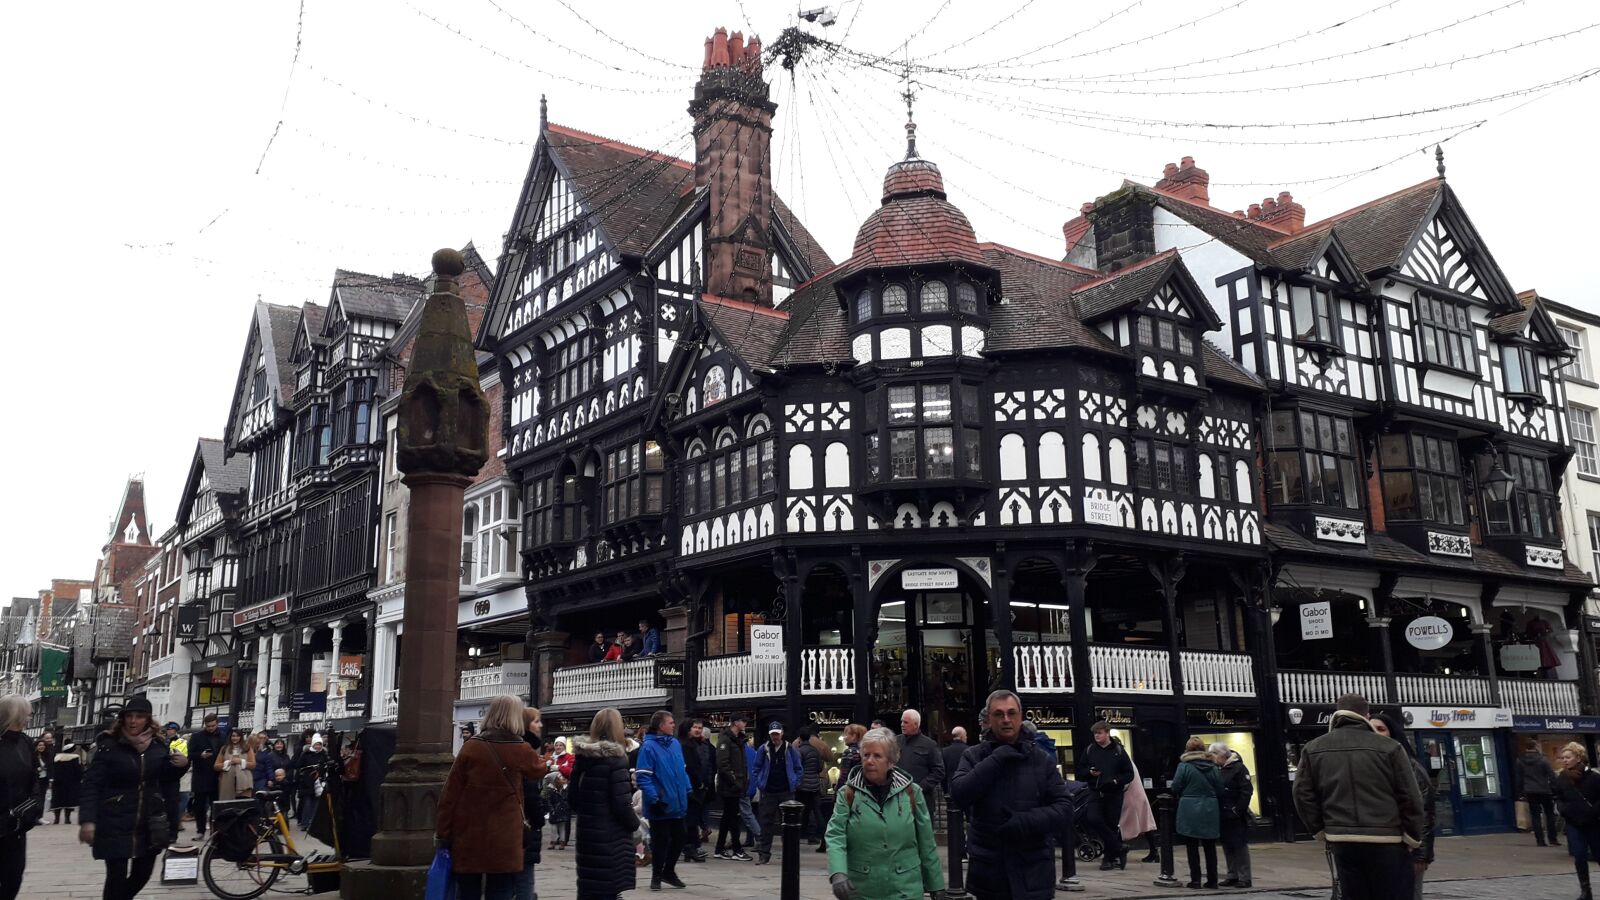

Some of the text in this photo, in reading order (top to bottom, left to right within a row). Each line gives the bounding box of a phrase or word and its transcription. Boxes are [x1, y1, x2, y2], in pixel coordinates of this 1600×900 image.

[1090, 502, 1111, 512] BRIDGE
[1090, 511, 1112, 522] STREET
[1302, 607, 1328, 618] Gabor
[181, 623, 194, 633] W
[753, 628, 780, 640] Gabor
[1408, 624, 1449, 637] POWELLS
[340, 662, 358, 670] LAKE
[340, 668, 360, 676] LAND
[808, 711, 850, 725] Waltons
[1026, 709, 1069, 725] Waltons
[1101, 708, 1132, 724] Waltons
[1206, 711, 1235, 725] Waltons
[1430, 709, 1476, 722] Hays Travel
[1545, 718, 1574, 730] Leonidas
